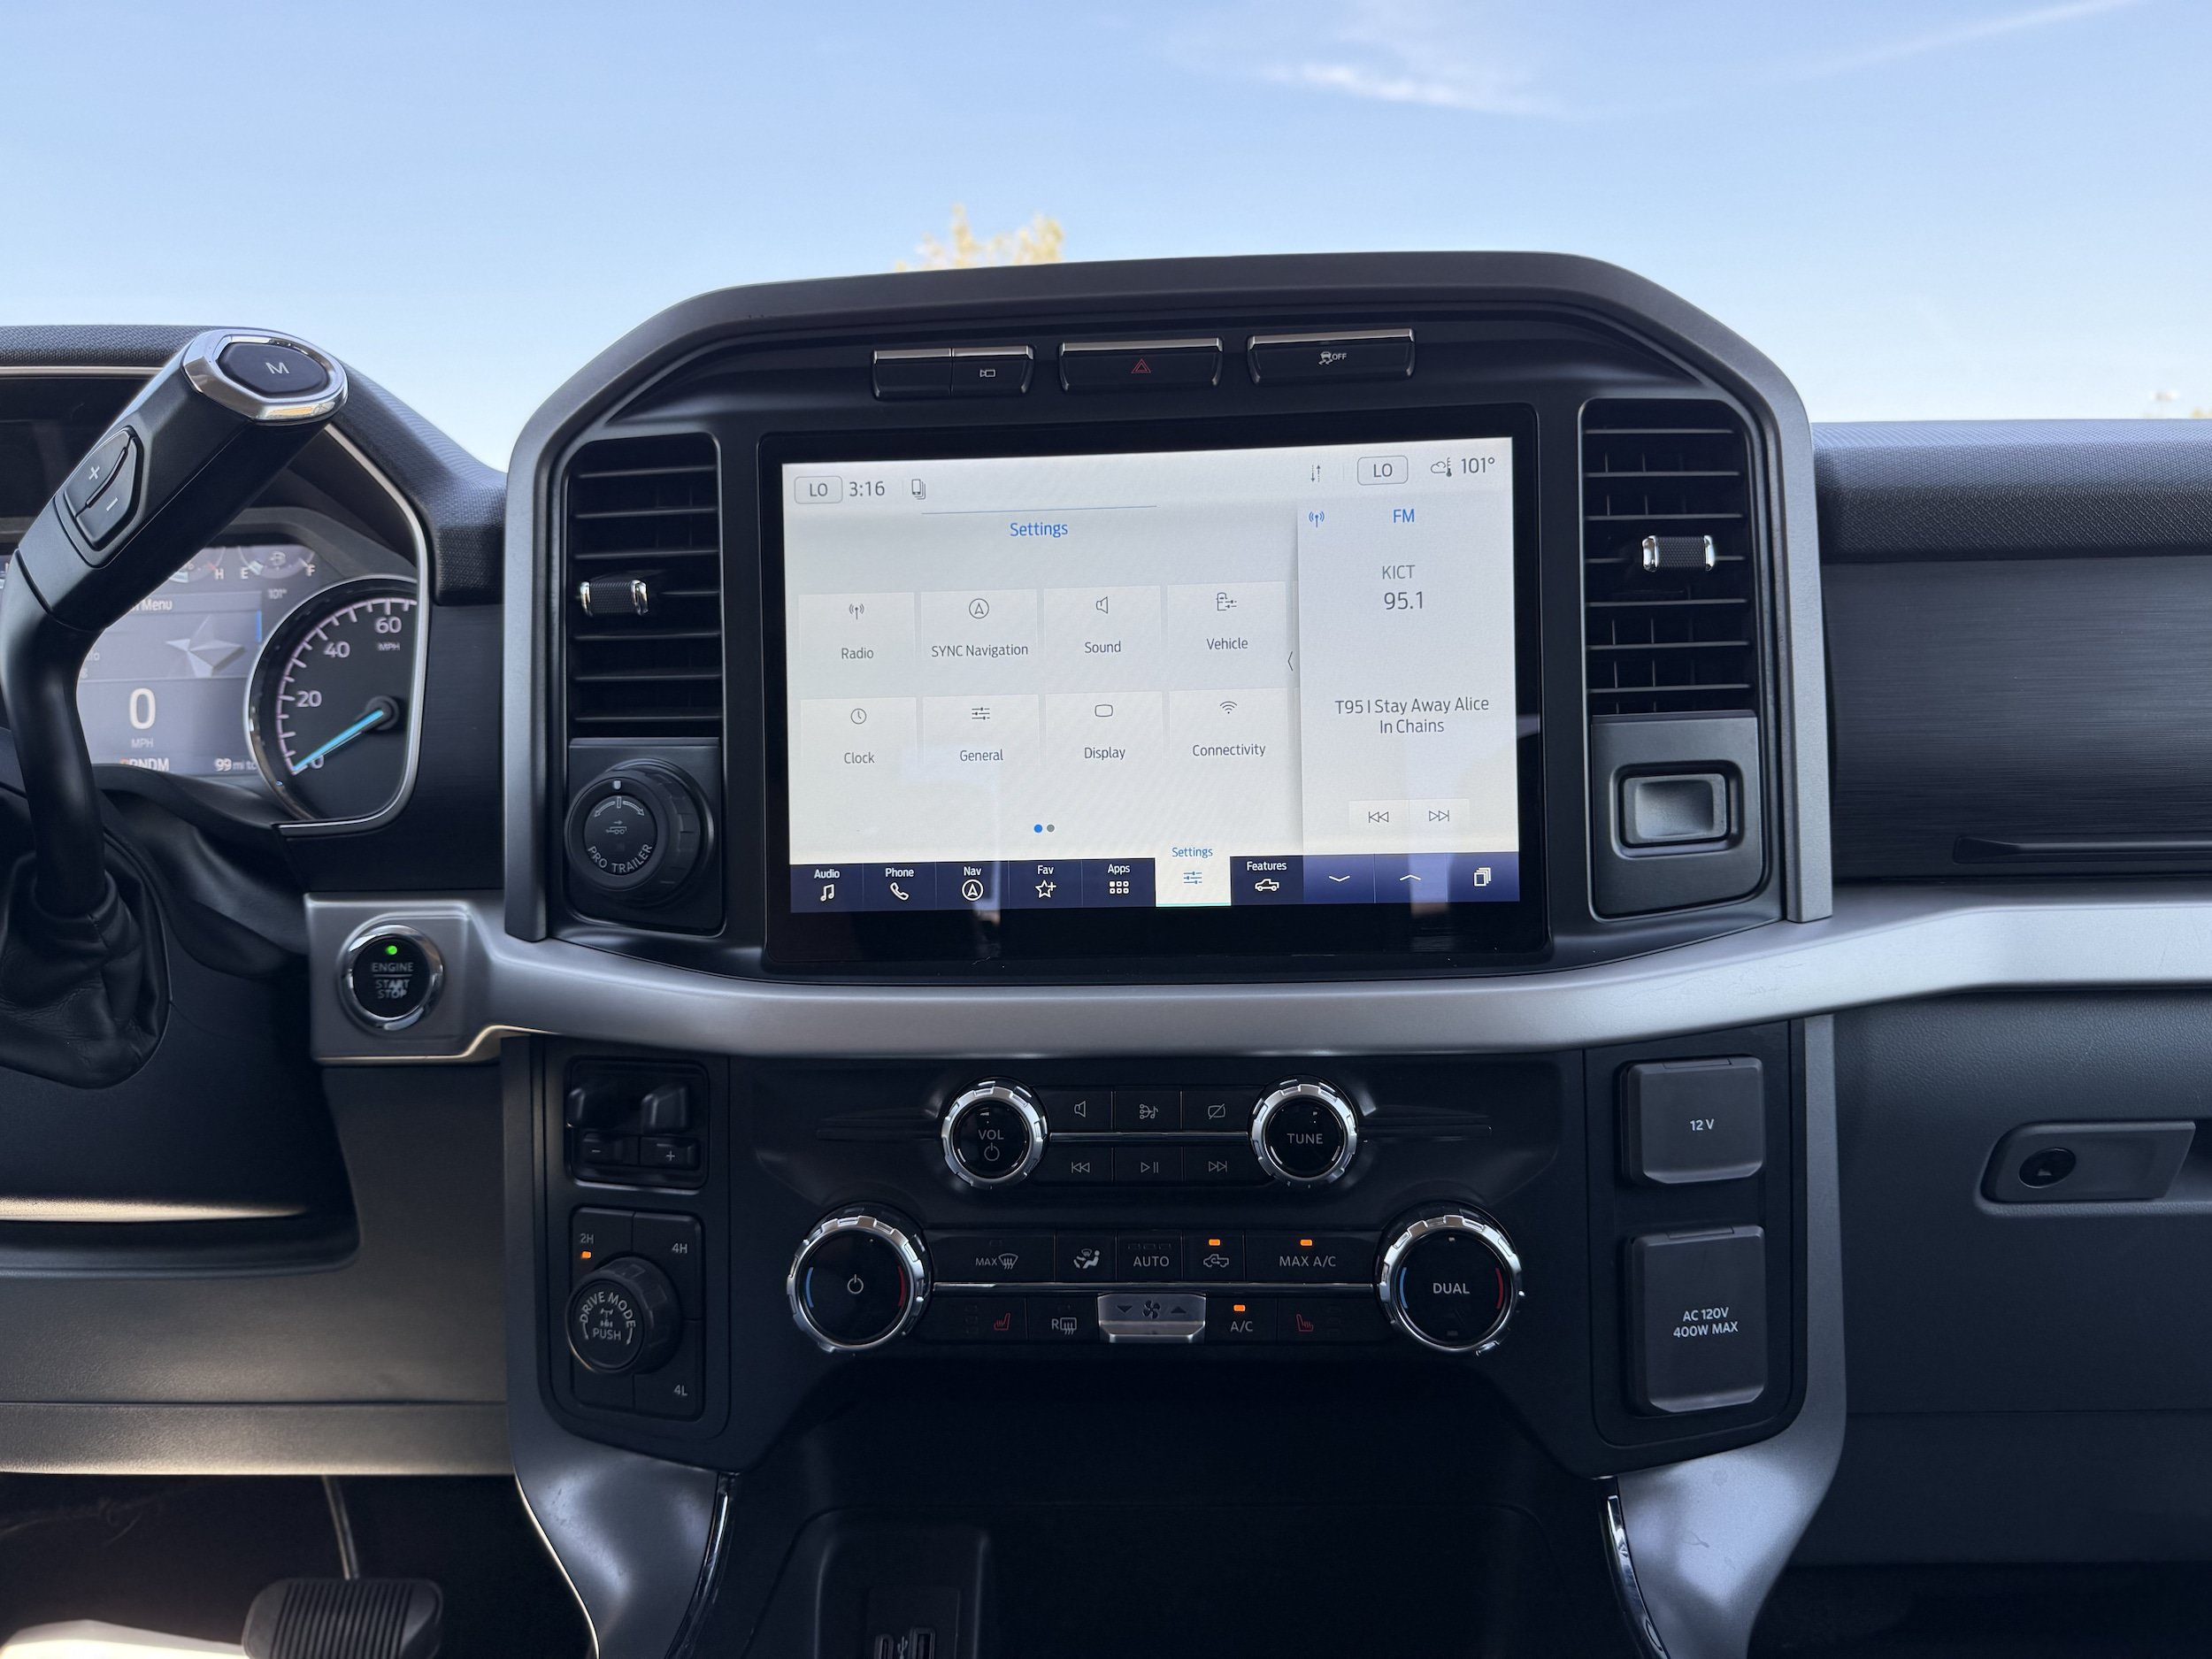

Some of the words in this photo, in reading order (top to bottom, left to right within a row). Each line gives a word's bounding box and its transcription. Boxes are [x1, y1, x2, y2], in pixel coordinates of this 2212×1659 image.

[1332, 352, 1348, 361] OFF
[265, 362, 290, 374] M
[1373, 464, 1394, 478] LO
[1461, 457, 1495, 474] 101°
[809, 482, 828, 497] LO
[849, 480, 886, 497] 3:16
[1393, 509, 1415, 524] FM
[1010, 521, 1069, 538] Settings
[1382, 565, 1416, 580] KICT
[142, 599, 173, 611] Menu
[1383, 591, 1424, 610] 95.1
[375, 617, 402, 634] 60
[324, 641, 350, 658] 40
[378, 642, 400, 652] MPH
[1084, 640, 1122, 654] Sound
[1206, 637, 1248, 651] Vehicle
[841, 647, 874, 660] Radio
[931, 644, 964, 658] SYNC
[965, 643, 1029, 659] Navigation
[296, 690, 322, 708] 20
[1335, 699, 1363, 715] T95
[1374, 698, 1407, 715] Stay
[1411, 697, 1453, 715] Away
[1455, 696, 1489, 711] Alice
[129, 687, 157, 730] 0
[1379, 720, 1393, 734] In
[1395, 718, 1445, 734] Chains
[131, 738, 154, 749] MPH
[960, 748, 1003, 762] General
[1084, 746, 1125, 761] Display
[1192, 743, 1266, 758] Connectivity
[844, 751, 875, 764] Clock
[213, 757, 232, 772] 99
[233, 760, 244, 771] mi
[588, 846, 608, 869] PRO
[611, 843, 653, 873] TRAILER
[1171, 846, 1213, 859] Settings
[963, 866, 982, 877] Nav
[1037, 864, 1054, 875] Fav
[1107, 863, 1131, 876] Apps
[1246, 860, 1287, 872] Features
[814, 868, 841, 879] Audio
[885, 867, 914, 879] Phone
[372, 962, 414, 972] ENGINE
[376, 979, 411, 989] START
[378, 989, 407, 999] STOP
[1690, 1119, 1704, 1132] 12
[1705, 1119, 1715, 1131] V
[978, 1129, 1004, 1141] VOL
[1286, 1133, 1324, 1145] TUNE
[580, 1233, 595, 1244] 2H
[672, 1242, 688, 1254] 4H
[975, 1256, 998, 1267] MAX
[1133, 1256, 1170, 1268] AUTO
[1279, 1256, 1310, 1268] MAX
[1313, 1255, 1337, 1268] A/C
[1432, 1282, 1471, 1294] DUAL
[580, 1291, 606, 1324] DRIVE
[608, 1292, 636, 1328] MODE
[1683, 1309, 1699, 1321] AC
[1701, 1306, 1729, 1320] 120V
[1230, 1320, 1254, 1333] A/C
[1673, 1324, 1709, 1339] 400W
[1711, 1321, 1739, 1334] MAX
[593, 1327, 621, 1341] PUSH
[673, 1385, 687, 1396] 4L
